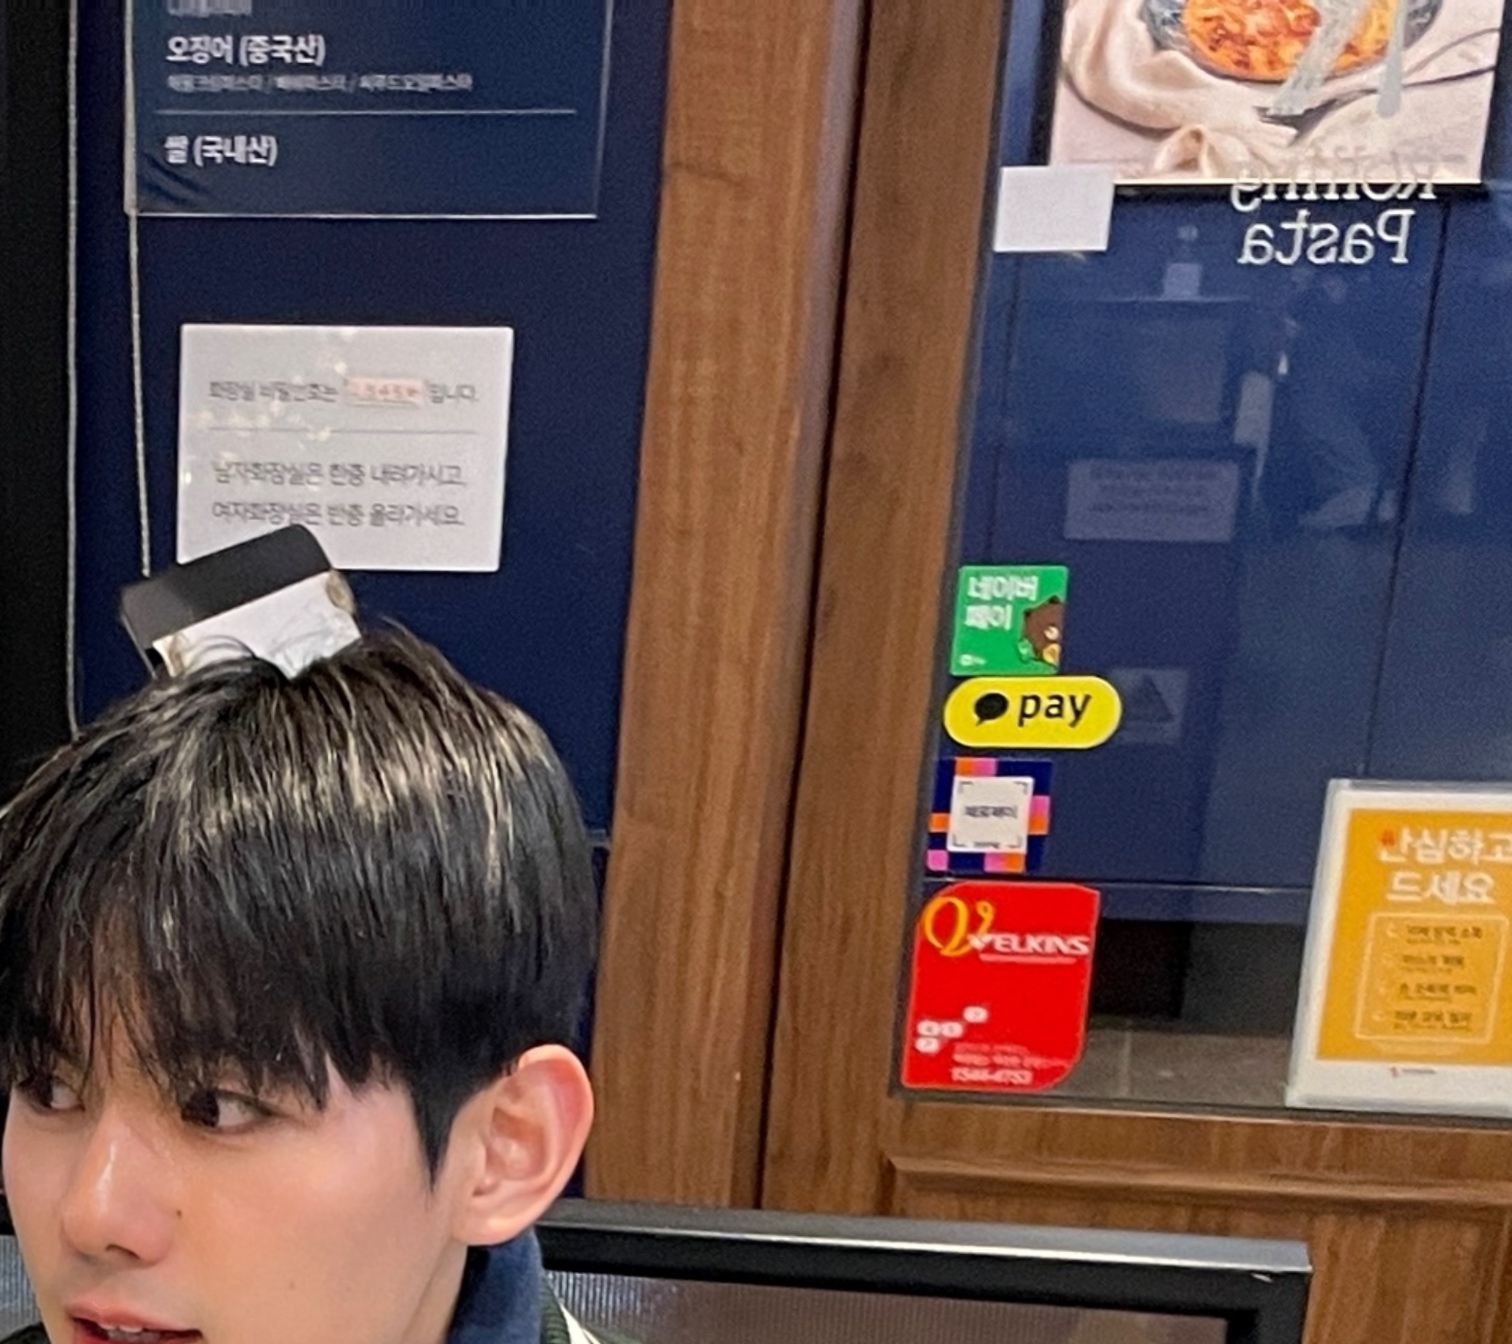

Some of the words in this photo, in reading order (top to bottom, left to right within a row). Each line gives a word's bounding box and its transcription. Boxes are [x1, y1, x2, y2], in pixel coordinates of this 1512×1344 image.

[166, 35, 233, 64] 오징어
[239, 35, 326, 66] (중국산)
[193, 135, 278, 167] (국내산)
[1018, 694, 1092, 728] pay
[1385, 871, 1496, 906] 드세요
